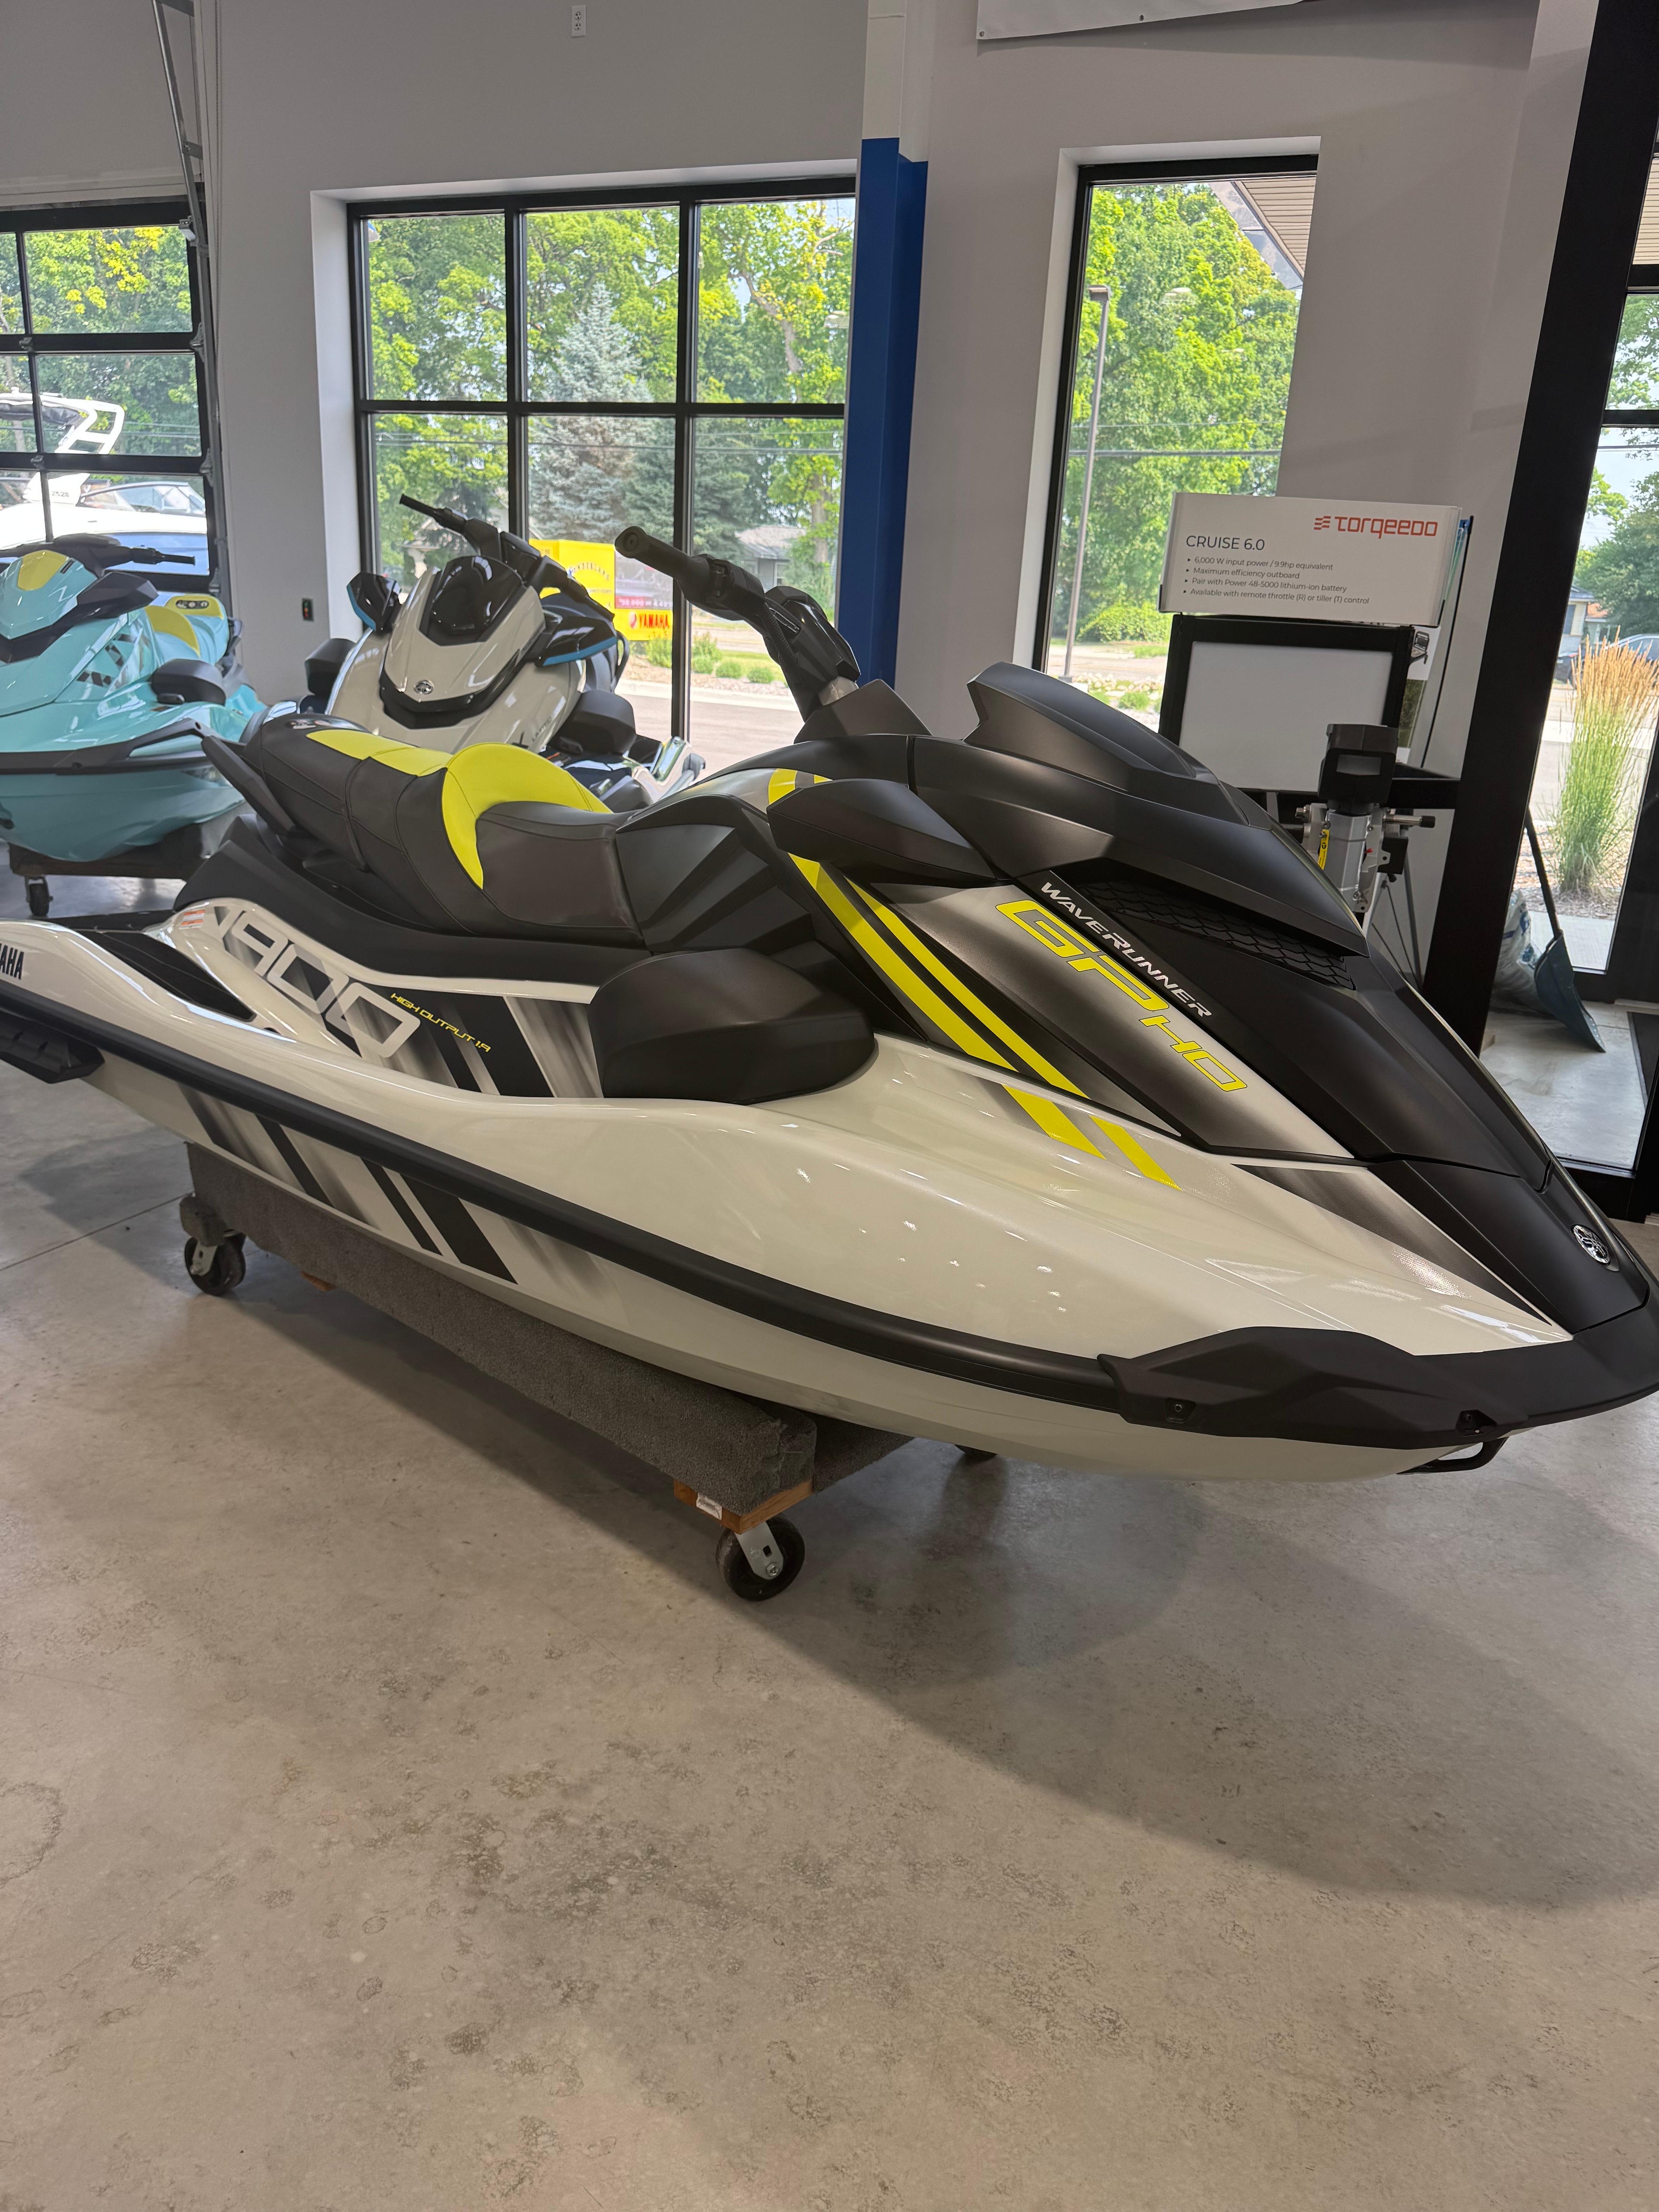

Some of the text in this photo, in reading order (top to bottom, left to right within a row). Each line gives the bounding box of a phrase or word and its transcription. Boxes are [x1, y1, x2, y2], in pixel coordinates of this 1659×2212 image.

[1186, 536, 1265, 550] CRUISE 6.0
[1231, 569, 1266, 578] efficiency
[1280, 582, 1320, 591] lithium-ion
[1321, 584, 1347, 593] battery
[1334, 596, 1342, 604] (T)
[1041, 882, 1212, 1017] WAVERUNNER
[0, 943, 24, 980] AHA
[390, 993, 491, 1052] HIGH OUTPUT 1.9
